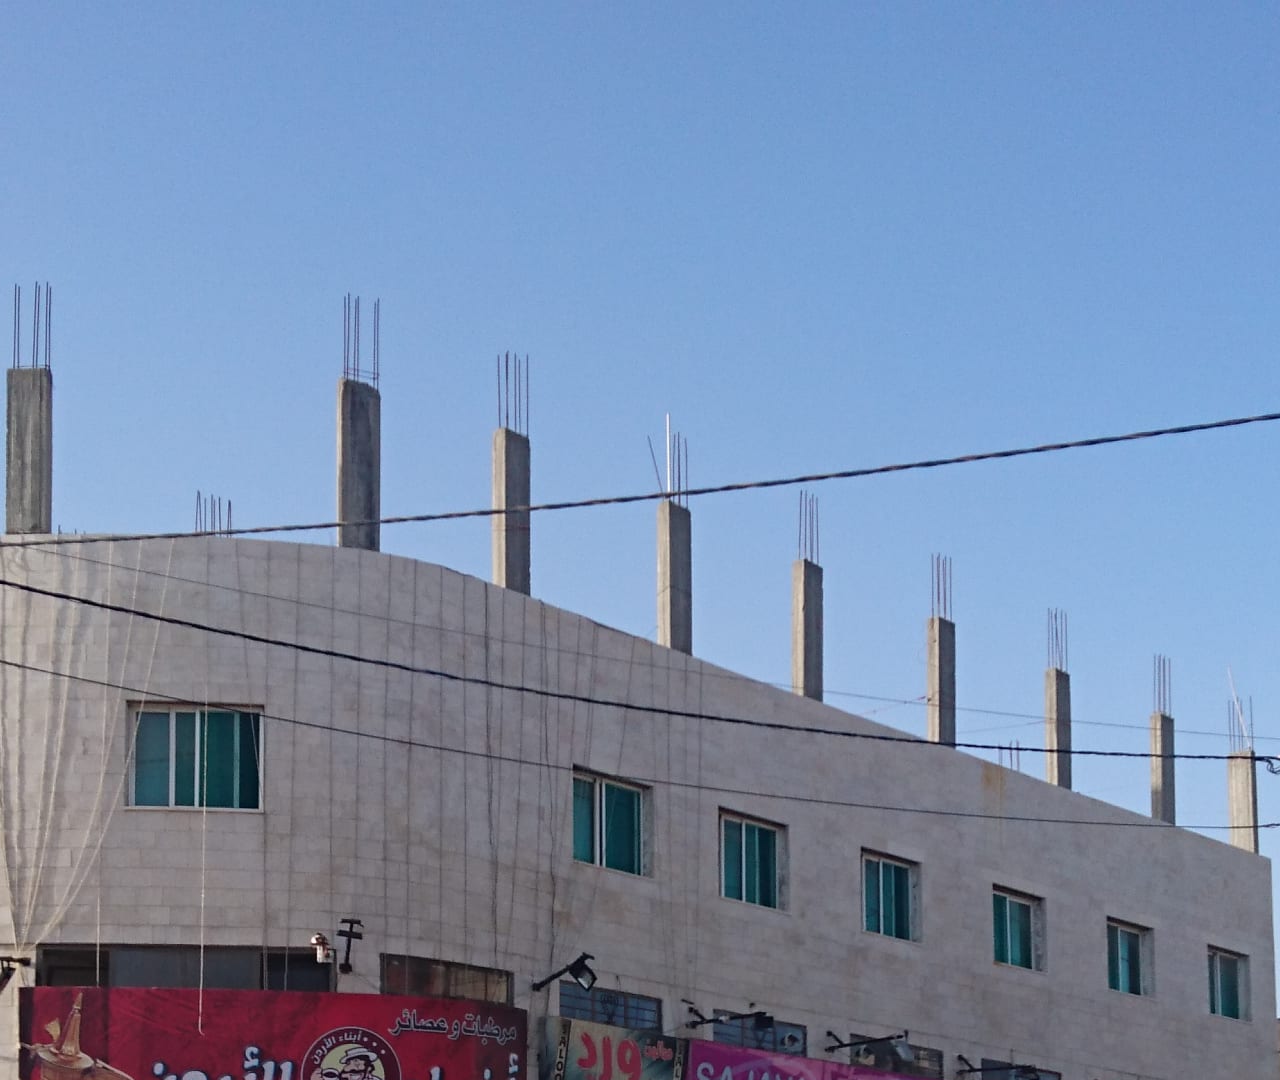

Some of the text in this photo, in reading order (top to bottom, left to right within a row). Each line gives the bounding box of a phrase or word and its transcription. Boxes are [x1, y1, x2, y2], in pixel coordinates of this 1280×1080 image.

[388, 1009, 517, 1046] مرطبات و عصائر
[312, 1030, 363, 1065] أبناء الأردن
